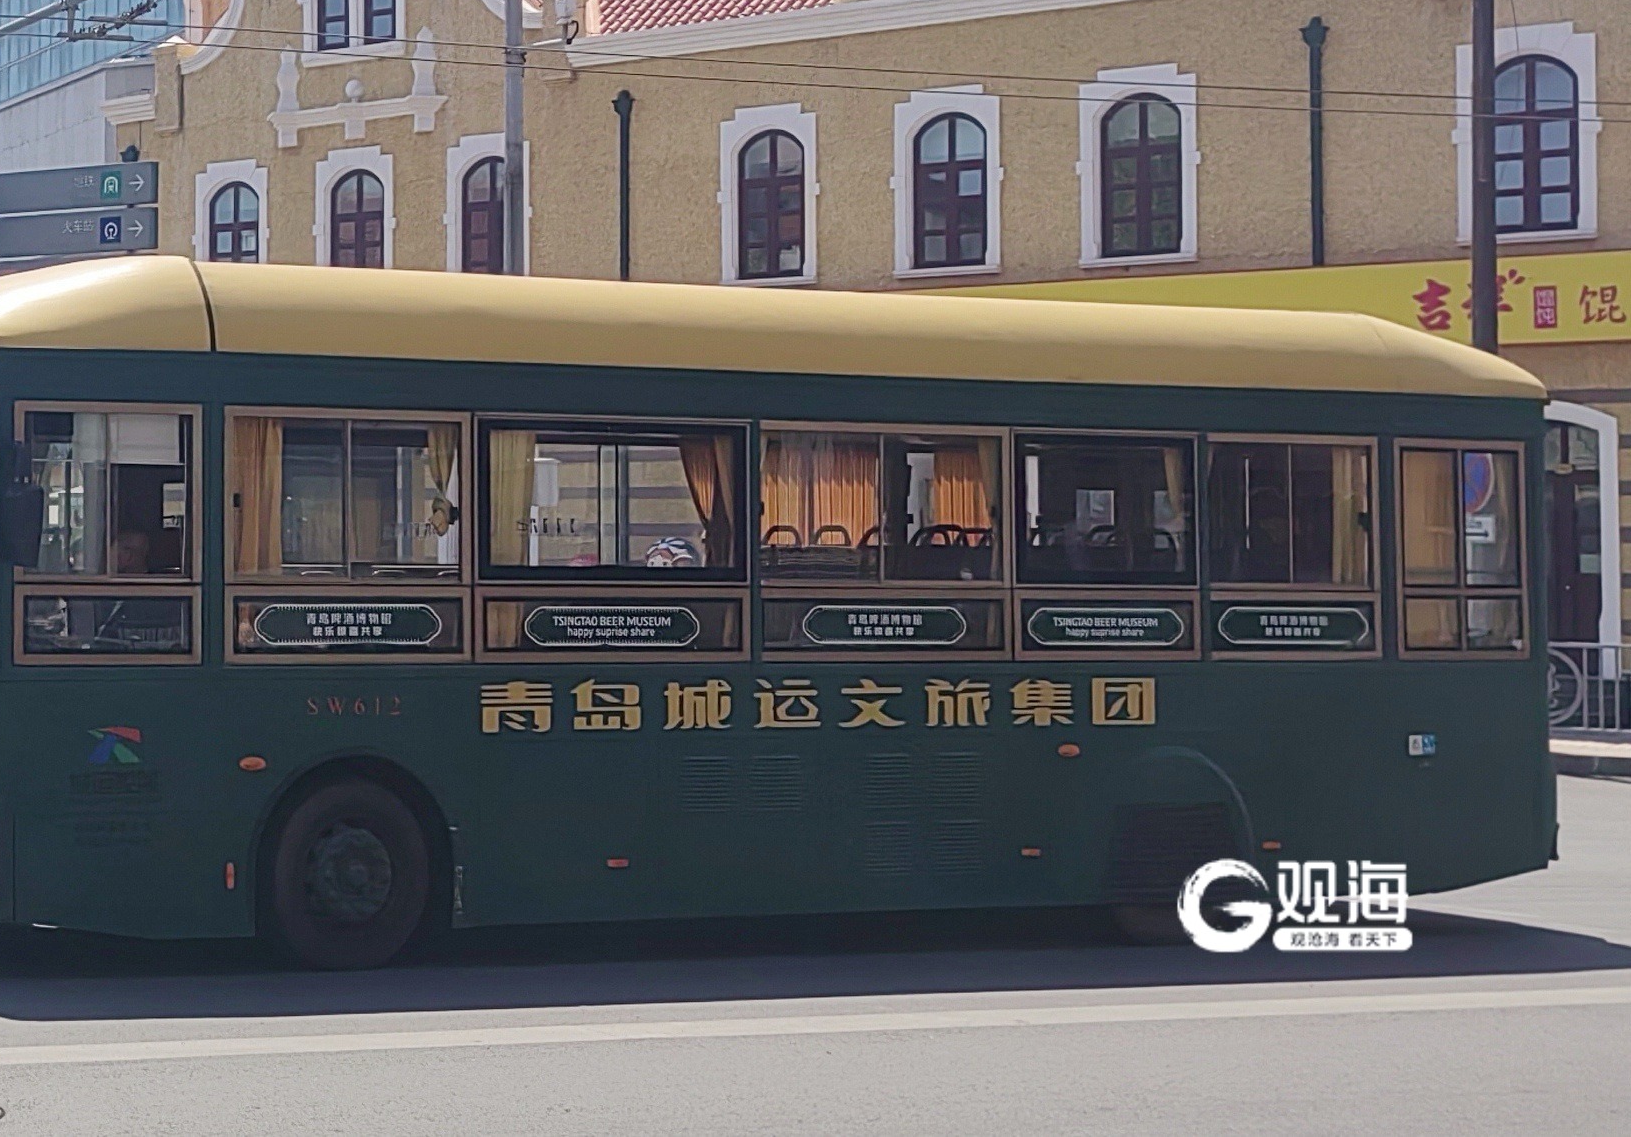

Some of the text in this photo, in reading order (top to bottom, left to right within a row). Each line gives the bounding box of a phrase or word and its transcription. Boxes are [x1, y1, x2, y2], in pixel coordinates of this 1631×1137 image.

[306, 613, 392, 625] 青岛啤酒博物馆
[553, 616, 671, 627] TSINGTAO BEER MUSEUM
[1053, 617, 1159, 627] TSINGTAO BEER MUSEUM
[568, 627, 594, 639] happy
[630, 627, 656, 637] share
[479, 676, 1157, 733] 青岛城运文旅集团
